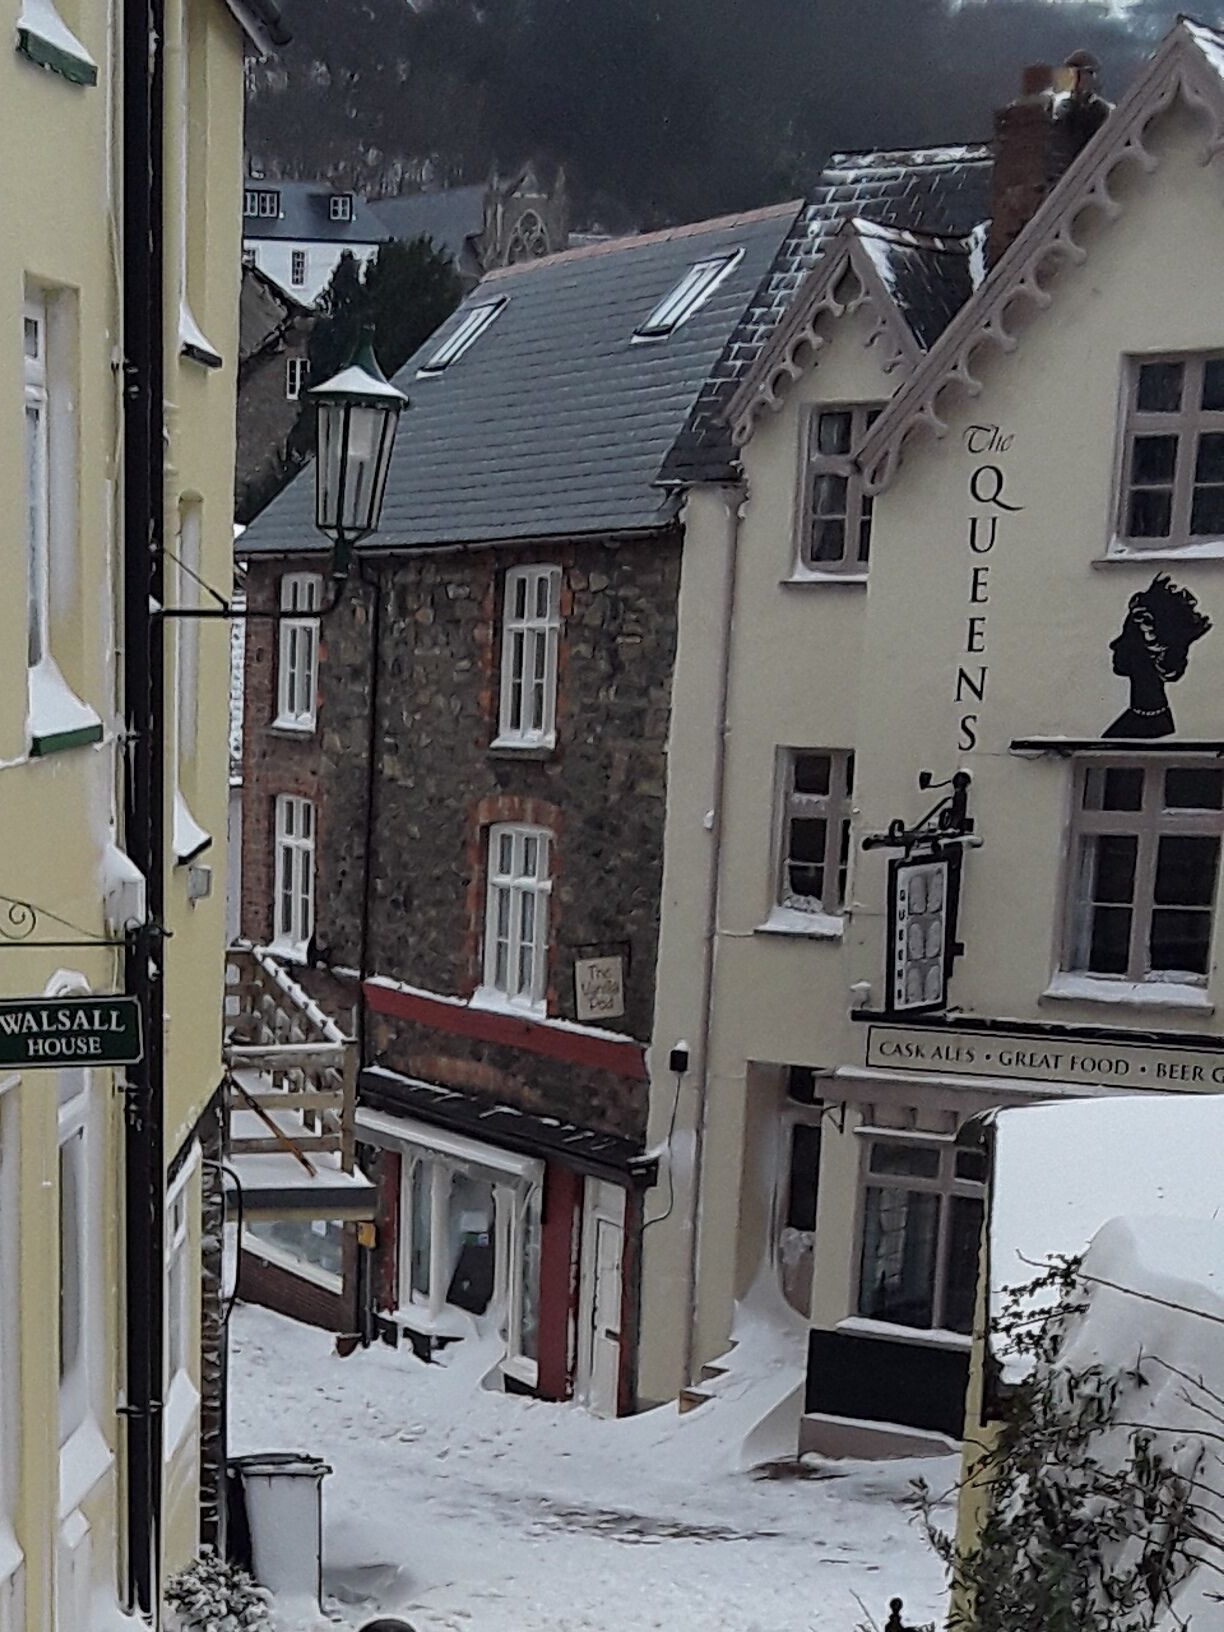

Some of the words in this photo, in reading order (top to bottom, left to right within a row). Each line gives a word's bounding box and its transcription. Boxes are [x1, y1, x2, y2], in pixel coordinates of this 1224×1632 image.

[963, 424, 1015, 454] The
[953, 464, 1025, 751] QUEENS
[27, 1036, 102, 1056] HOUSE
[879, 1041, 925, 1058] CASK
[931, 1045, 975, 1063] ALES
[999, 1050, 1064, 1070] GREAT
[1070, 1055, 1130, 1076] FOOD
[1156, 1062, 1205, 1082] BEER
